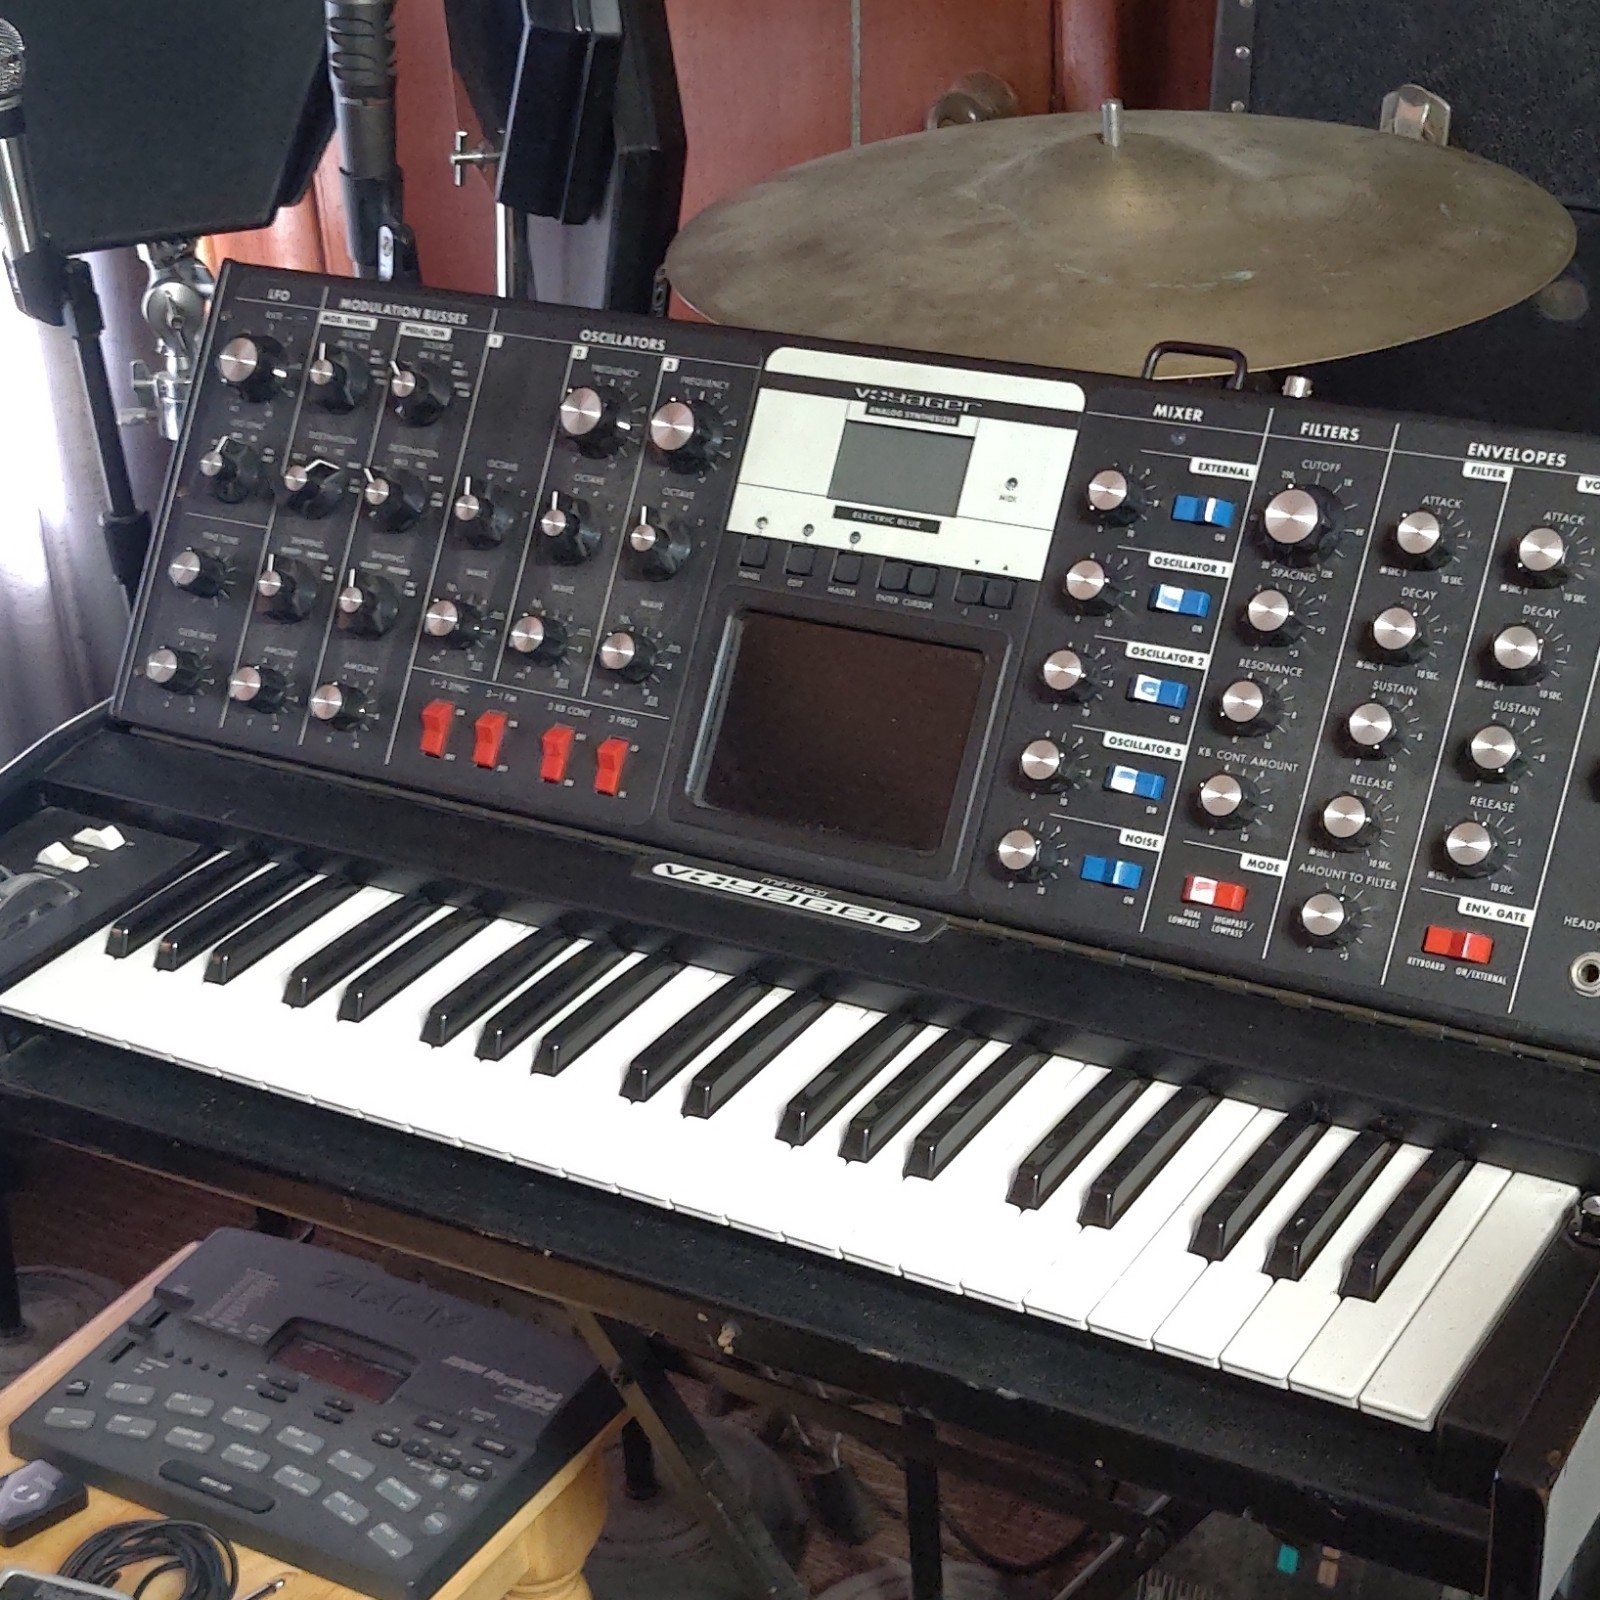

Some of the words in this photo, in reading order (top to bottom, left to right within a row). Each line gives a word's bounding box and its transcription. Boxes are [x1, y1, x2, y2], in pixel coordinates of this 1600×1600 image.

[267, 289, 290, 301] LFO
[338, 298, 421, 320] MODULATION
[422, 309, 469, 326] BUSSES
[579, 329, 667, 351] OSCILLATORS
[1152, 404, 1204, 422] MIXER
[1300, 421, 1361, 442] FILTERS
[1467, 442, 1567, 468] ENVELOPES
[1198, 462, 1250, 477] EXTERNAL
[1302, 458, 1341, 473] CUTOFF
[1471, 466, 1505, 479] FILTER
[1422, 495, 1464, 509] ATTACK
[852, 510, 894, 525] ELECTRIC
[1543, 511, 1586, 526] ATTACK
[1154, 556, 1218, 574] OSCILLATOR
[1271, 567, 1317, 583] SPACING
[1401, 586, 1438, 600] DECAY
[1523, 604, 1561, 619] DECAY
[1131, 646, 1194, 664] OSCILLATOR
[1238, 658, 1304, 678] RESONANCE
[1373, 680, 1418, 696] SUSTAIN
[1493, 700, 1541, 717] SUSTAIN
[1109, 736, 1171, 754] OSCILLATOR
[1250, 754, 1299, 773] AMOUNT
[1350, 774, 1394, 791] RELEASE
[1470, 796, 1515, 813] RELEASE
[1125, 834, 1158, 848] NOISE
[1247, 858, 1281, 873] MODE
[1376, 859, 1392, 871] SEC.
[1298, 864, 1348, 881] AMOUNT
[1349, 871, 1364, 883] TO
[1365, 875, 1398, 891] FILTER
[1498, 884, 1515, 895] SEC.
[1184, 908, 1201, 920] DUAL
[1465, 902, 1492, 916] ENV.
[1496, 909, 1526, 923] GATE
[1167, 915, 1201, 930] LOWPASS
[1211, 924, 1244, 938] LOWPASS
[1407, 956, 1446, 972] KEYBOARD
[1455, 967, 1508, 985] ON/EXTERNAL
